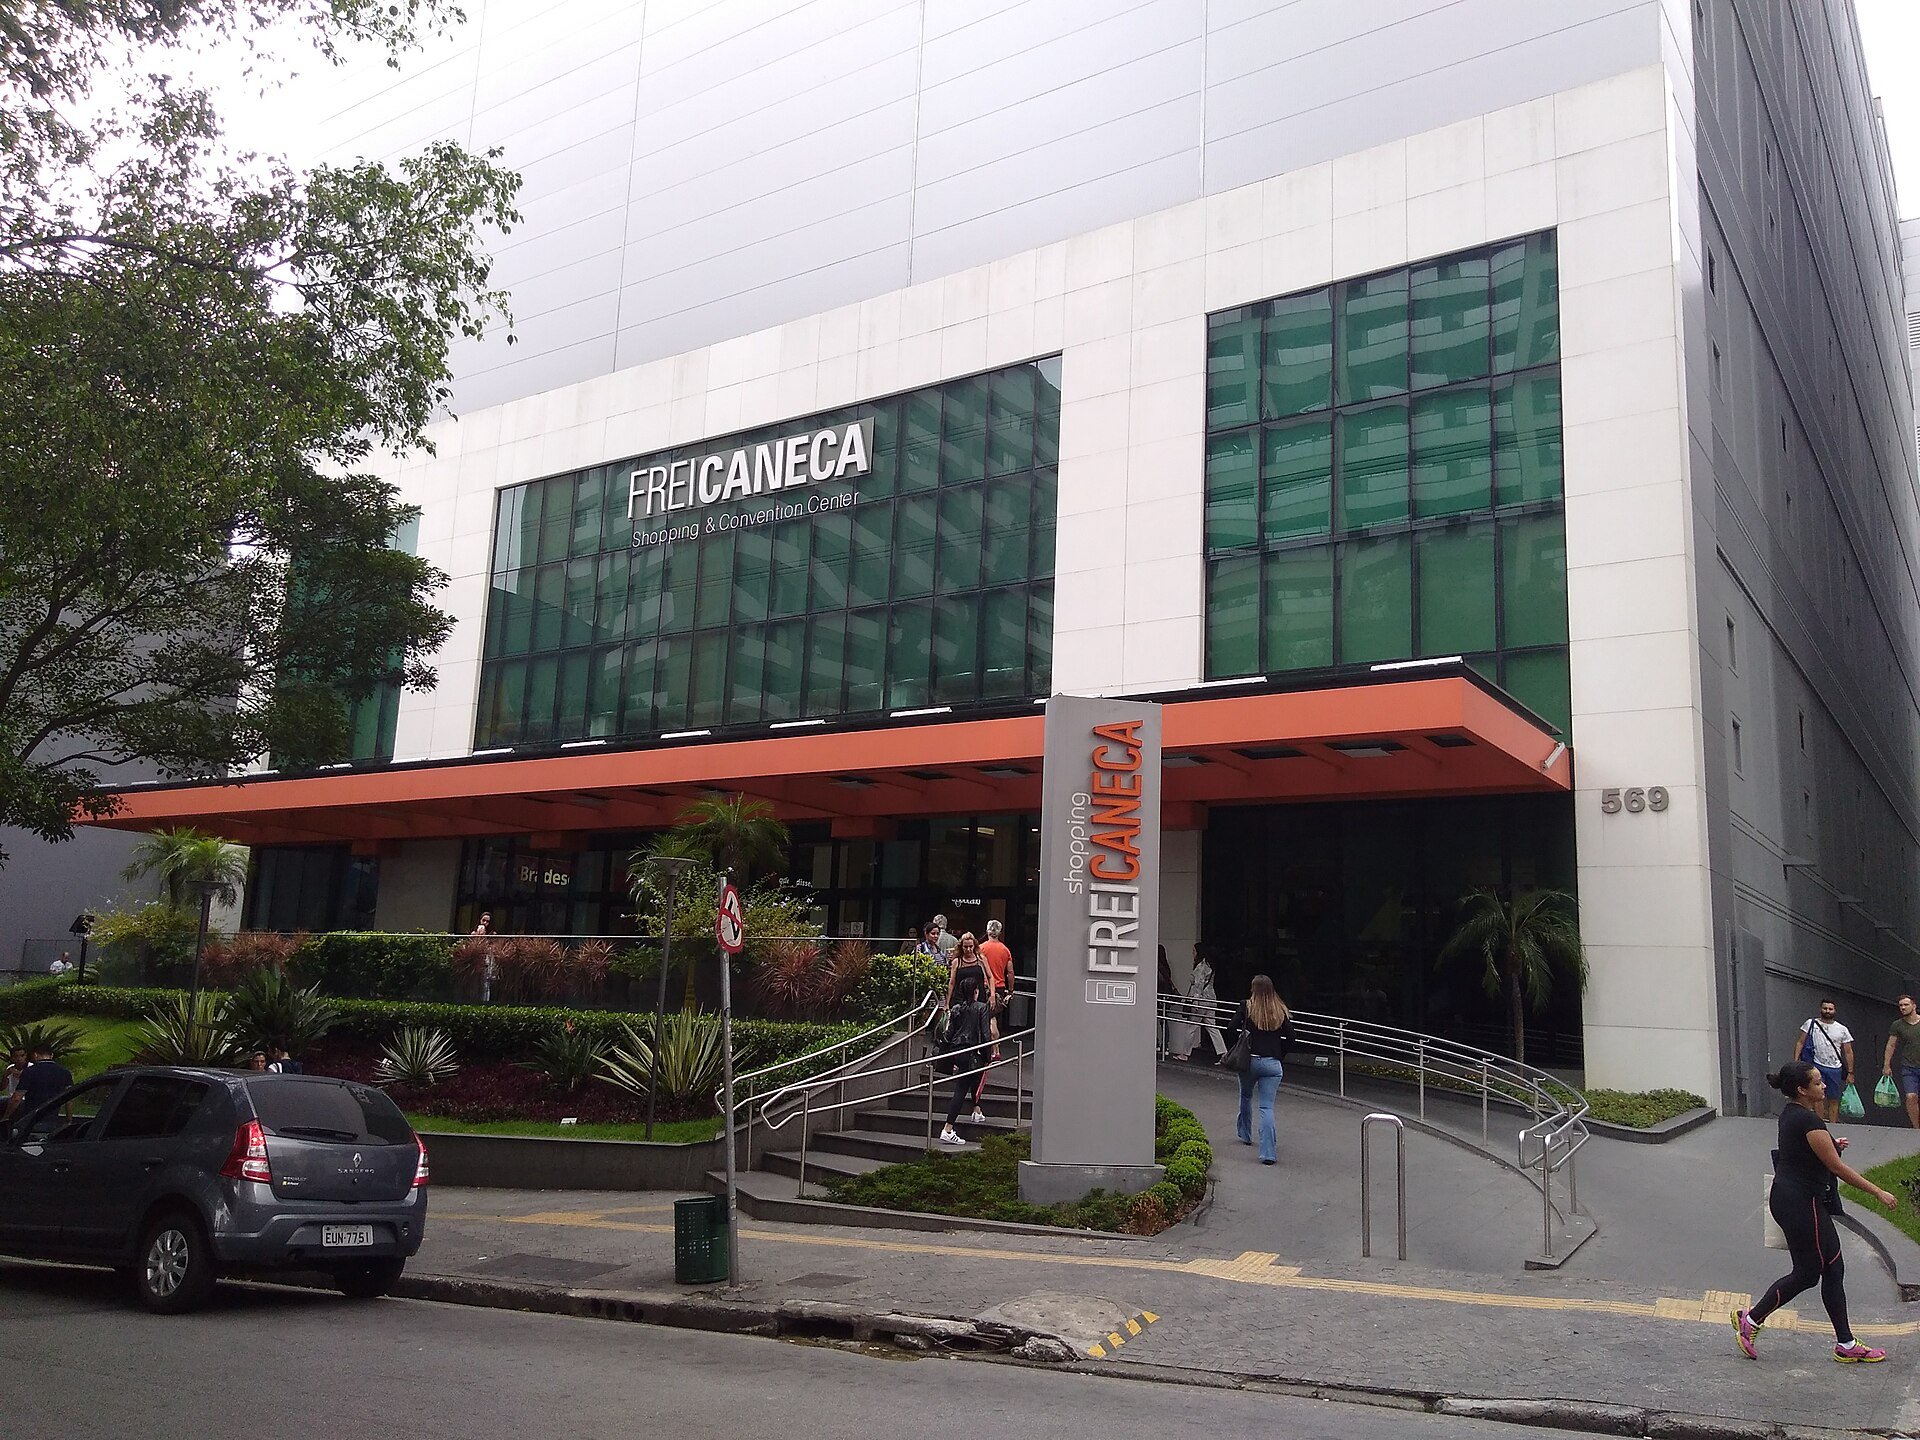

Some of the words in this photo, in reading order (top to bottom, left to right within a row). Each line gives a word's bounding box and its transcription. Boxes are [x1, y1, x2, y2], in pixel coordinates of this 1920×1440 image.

[632, 521, 699, 548] Shopping
[706, 516, 717, 534] &
[719, 501, 803, 532] Convention
[808, 491, 860, 514] Center
[1601, 786, 1669, 814] 569
[1063, 792, 1091, 894] shopping
